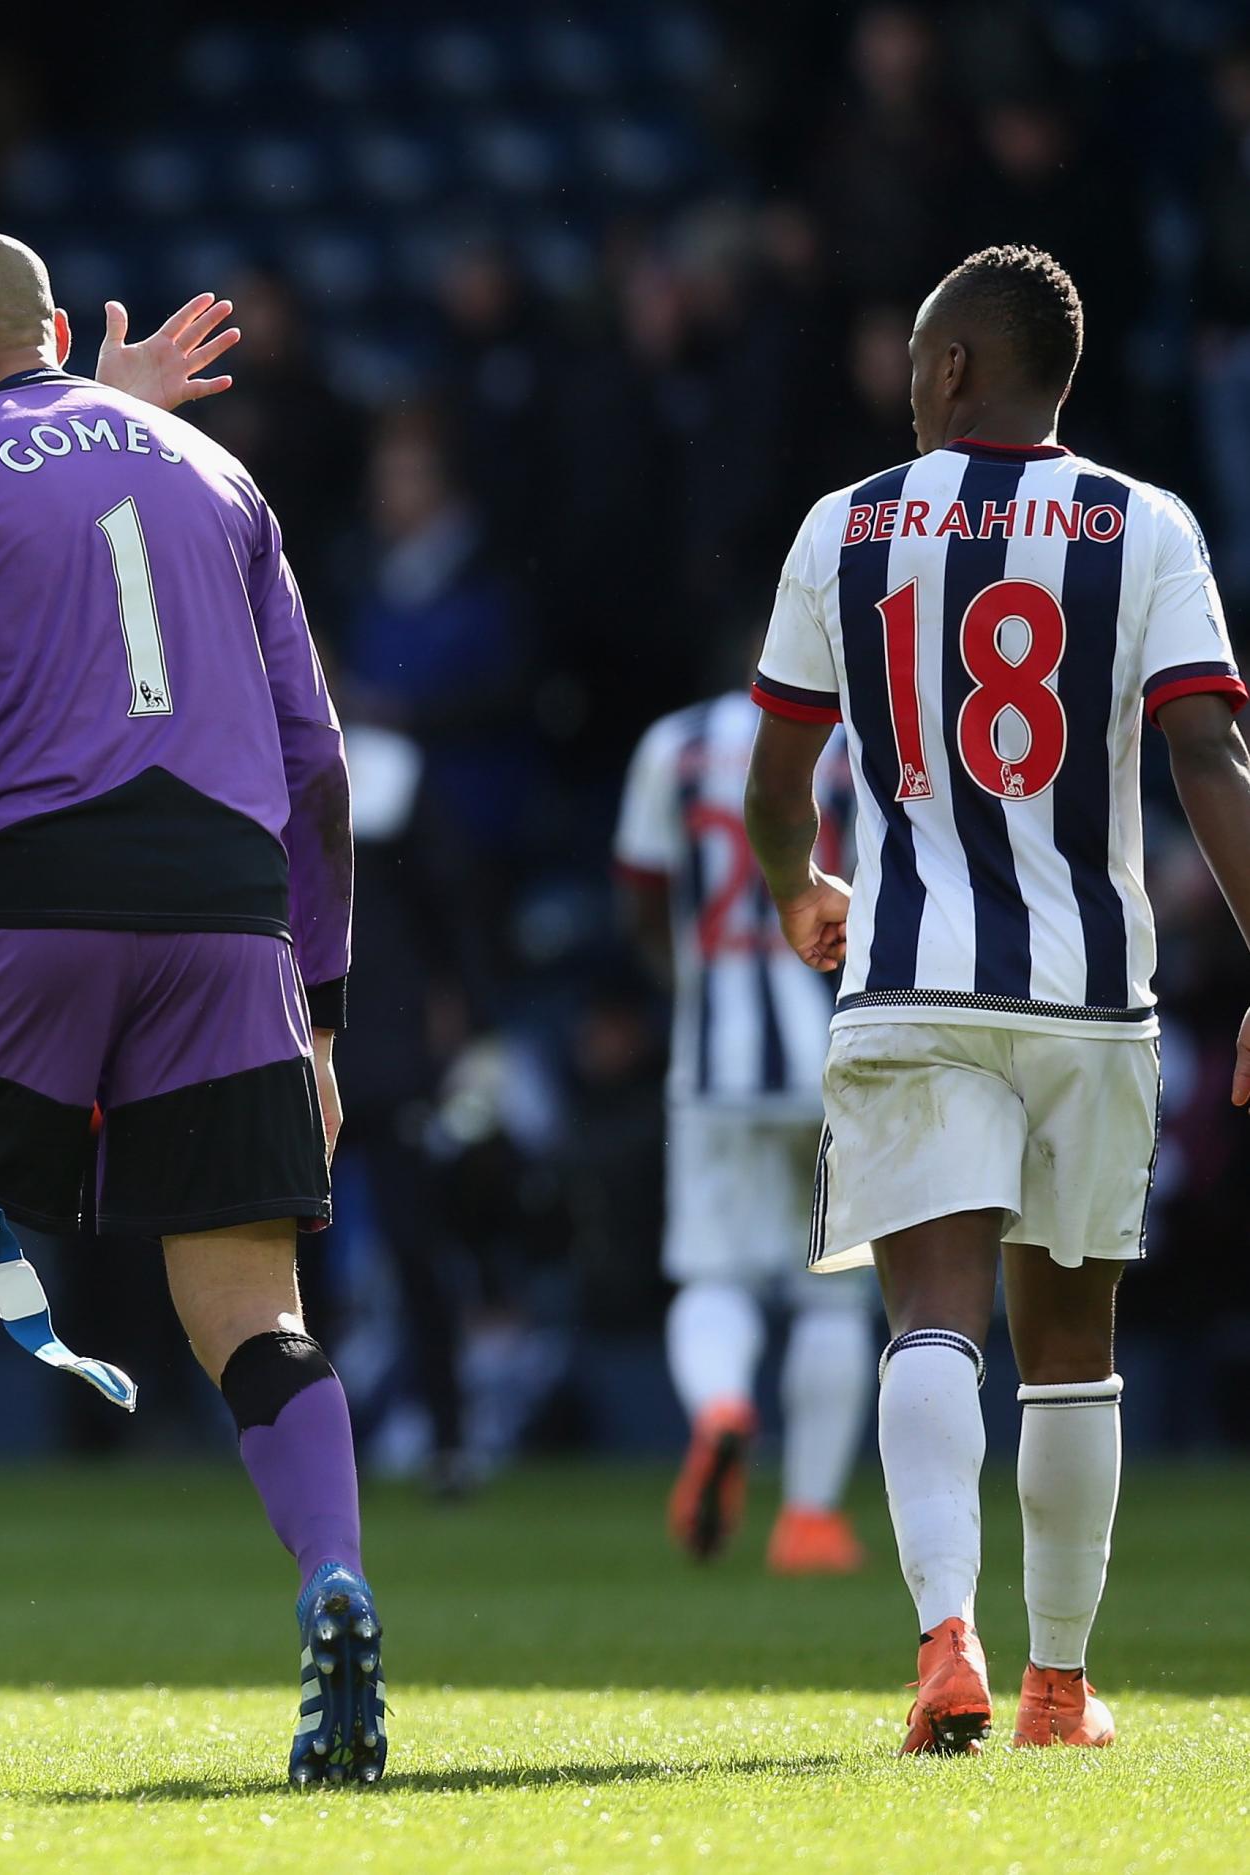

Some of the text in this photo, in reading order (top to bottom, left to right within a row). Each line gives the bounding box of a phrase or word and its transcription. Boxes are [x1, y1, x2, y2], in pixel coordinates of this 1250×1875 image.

[95, 495, 173, 717] 1
[842, 500, 1125, 546] BERAHINO
[873, 576, 1068, 802] 18
[684, 803, 842, 960] 2
